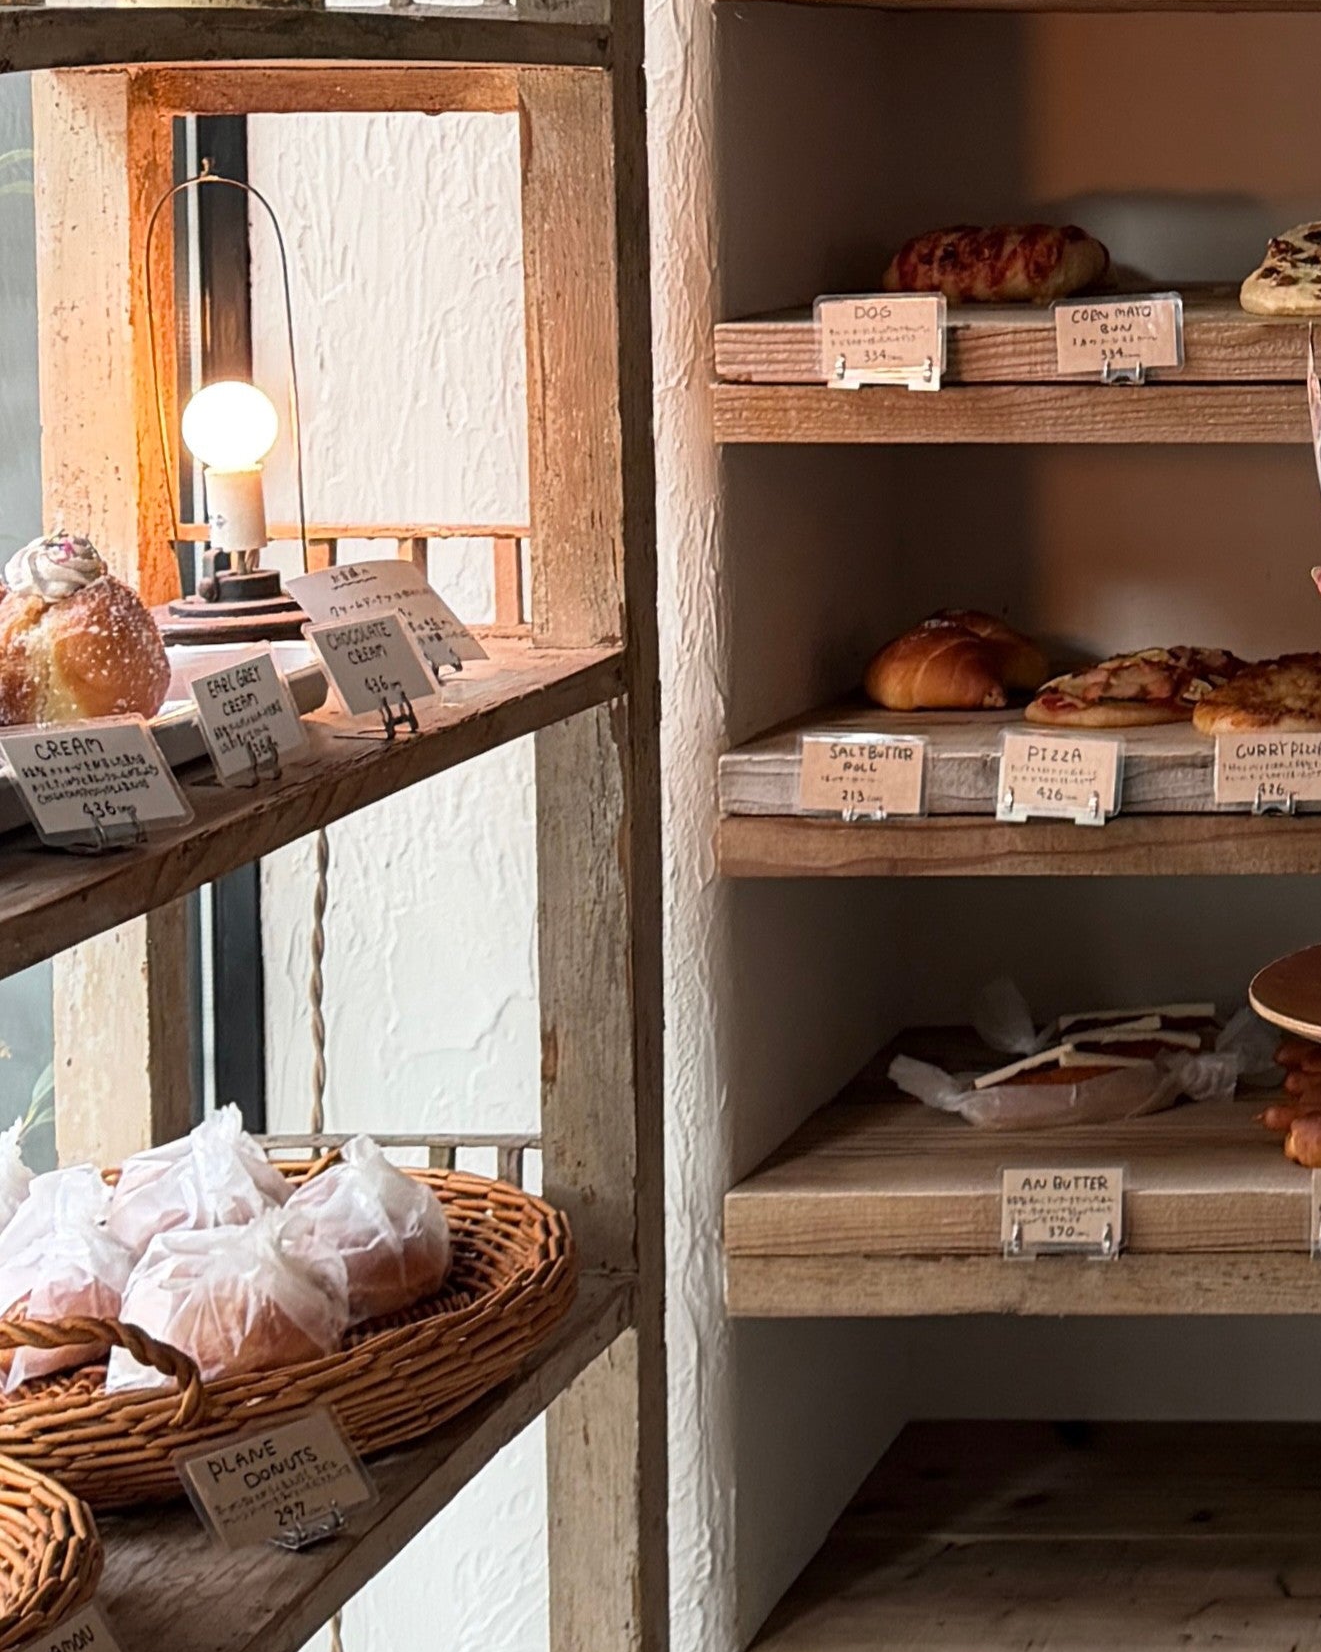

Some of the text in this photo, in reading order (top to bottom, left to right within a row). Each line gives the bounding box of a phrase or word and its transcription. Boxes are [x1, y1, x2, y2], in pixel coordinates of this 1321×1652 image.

[854, 306, 892, 319] DOG
[1100, 323, 1132, 334] BUN
[326, 621, 392, 650] CHOCOLATE
[348, 644, 387, 665] CREAM
[34, 737, 105, 761] CREAM
[1027, 745, 1082, 763] PIZZA
[1236, 740, 1287, 759] CURRY
[842, 790, 864, 802] 213
[1036, 786, 1063, 801] 426
[82, 800, 117, 818] 436
[1021, 1175, 1108, 1190] AN BUTTER
[207, 1439, 277, 1483] PLANE
[243, 1446, 318, 1489] DONUTS
